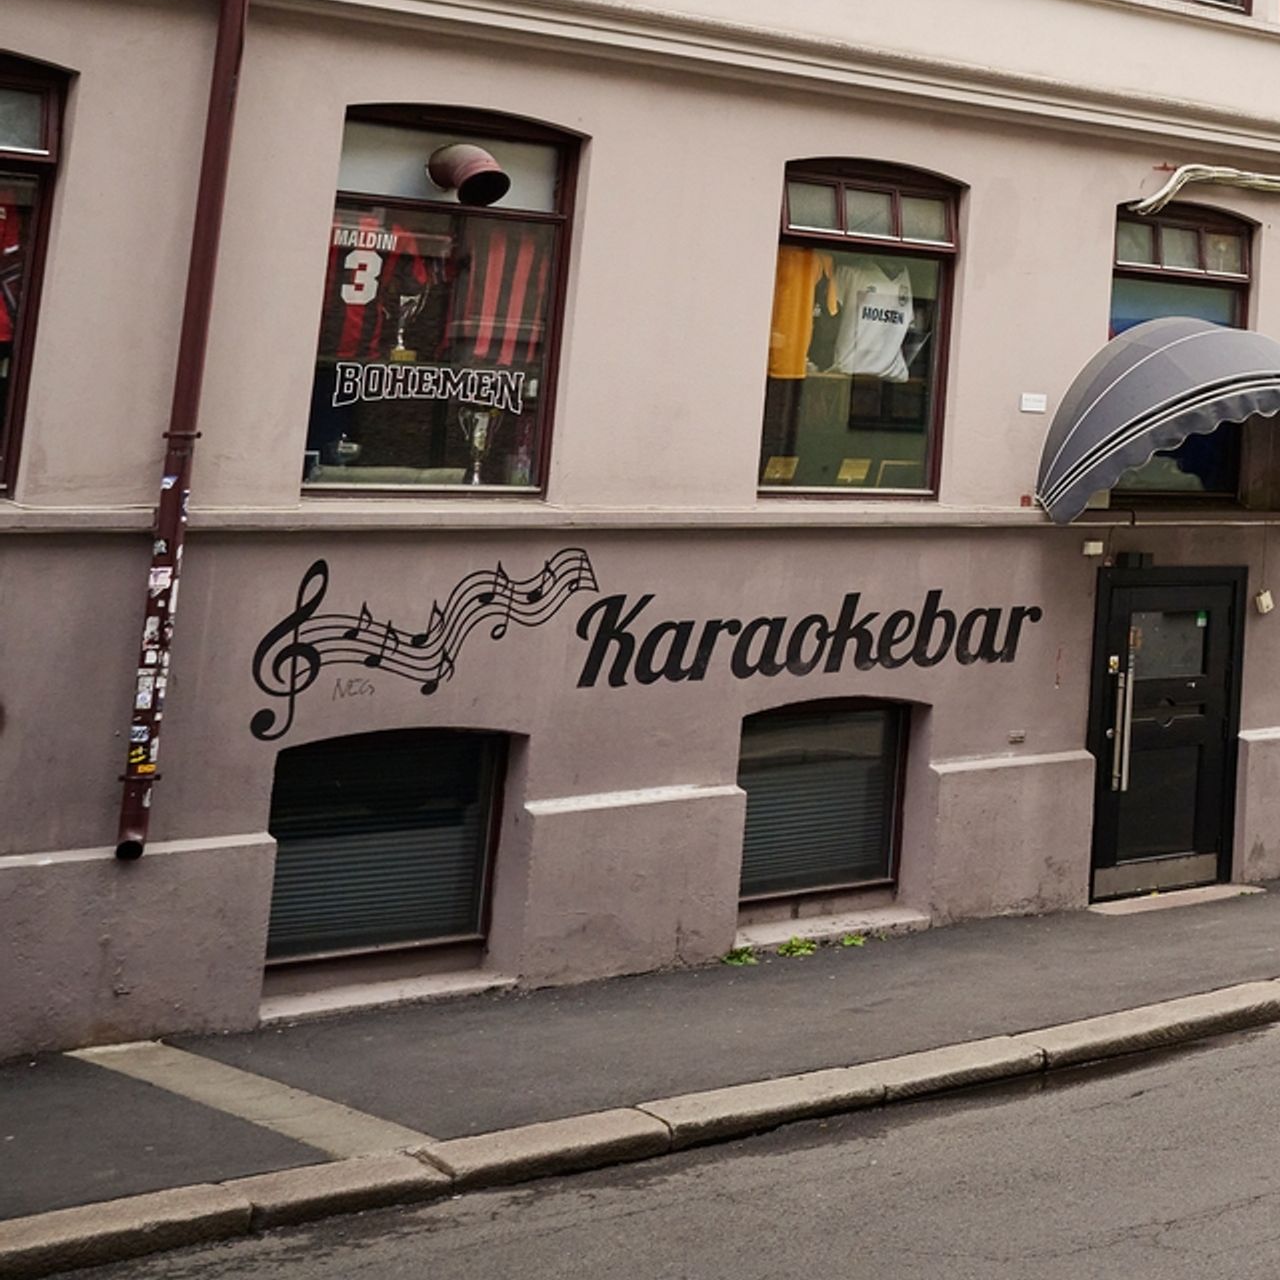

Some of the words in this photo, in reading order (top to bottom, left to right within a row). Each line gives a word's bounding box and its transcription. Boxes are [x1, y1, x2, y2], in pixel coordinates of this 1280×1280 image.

[341, 250, 383, 305] 3
[862, 306, 905, 324] HOLSTEN
[332, 362, 525, 414] BOHEMEN
[576, 589, 1042, 688] Karaokebar
